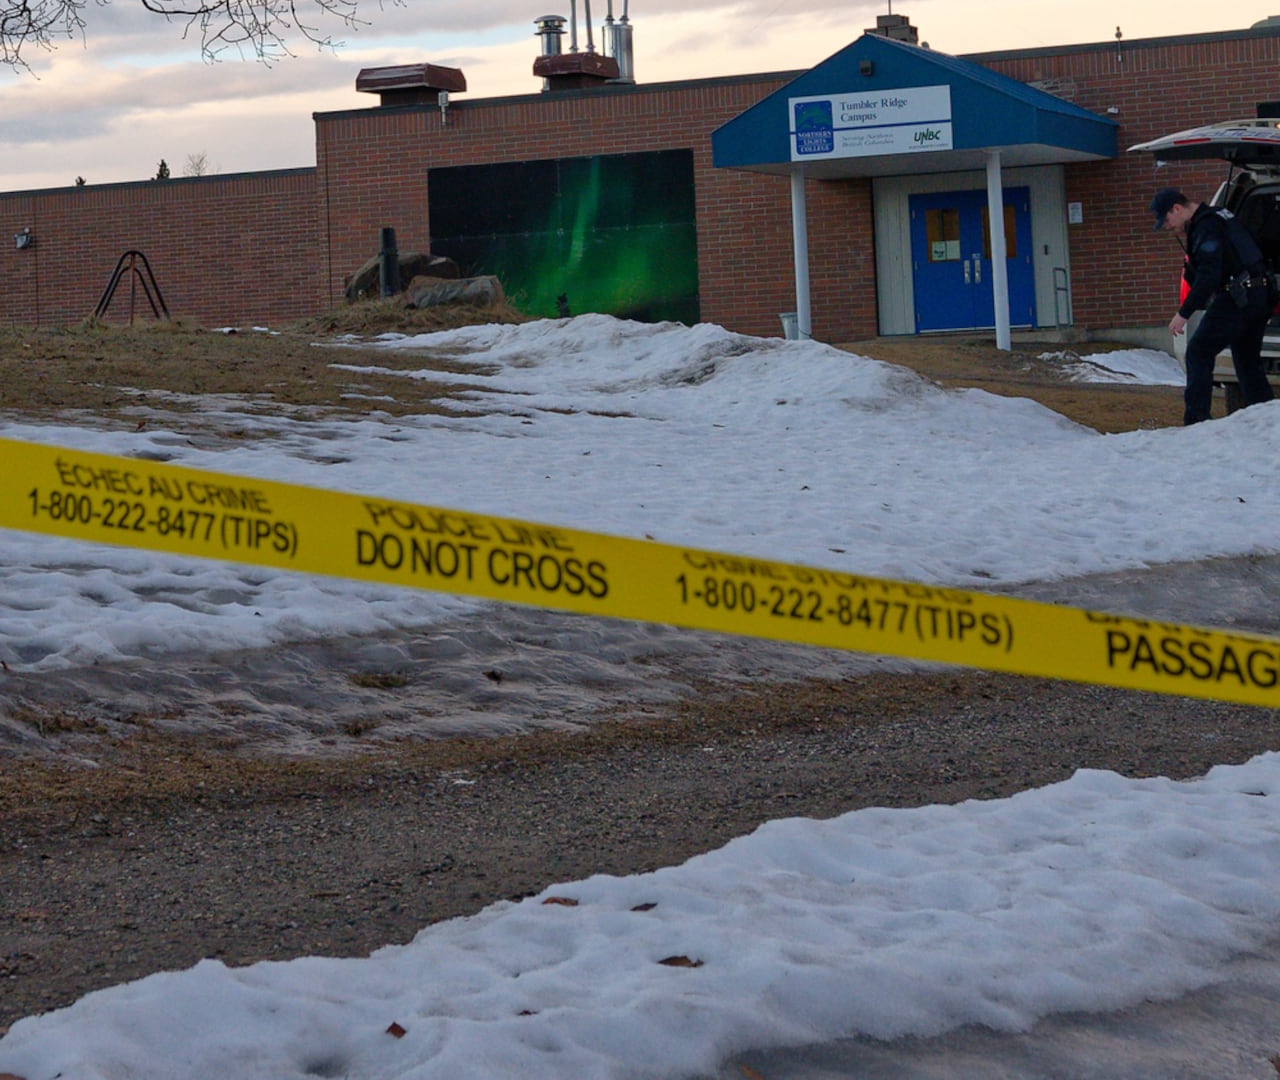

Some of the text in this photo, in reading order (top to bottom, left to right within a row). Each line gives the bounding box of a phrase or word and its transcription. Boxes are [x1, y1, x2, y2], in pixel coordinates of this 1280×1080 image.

[840, 98, 908, 111] Tumbler Ridge
[841, 113, 877, 123] Campus
[914, 128, 941, 144] UNBC
[149, 475, 184, 503] AU
[187, 481, 273, 514] CRIME
[356, 530, 611, 600] DO NOT CROSS
